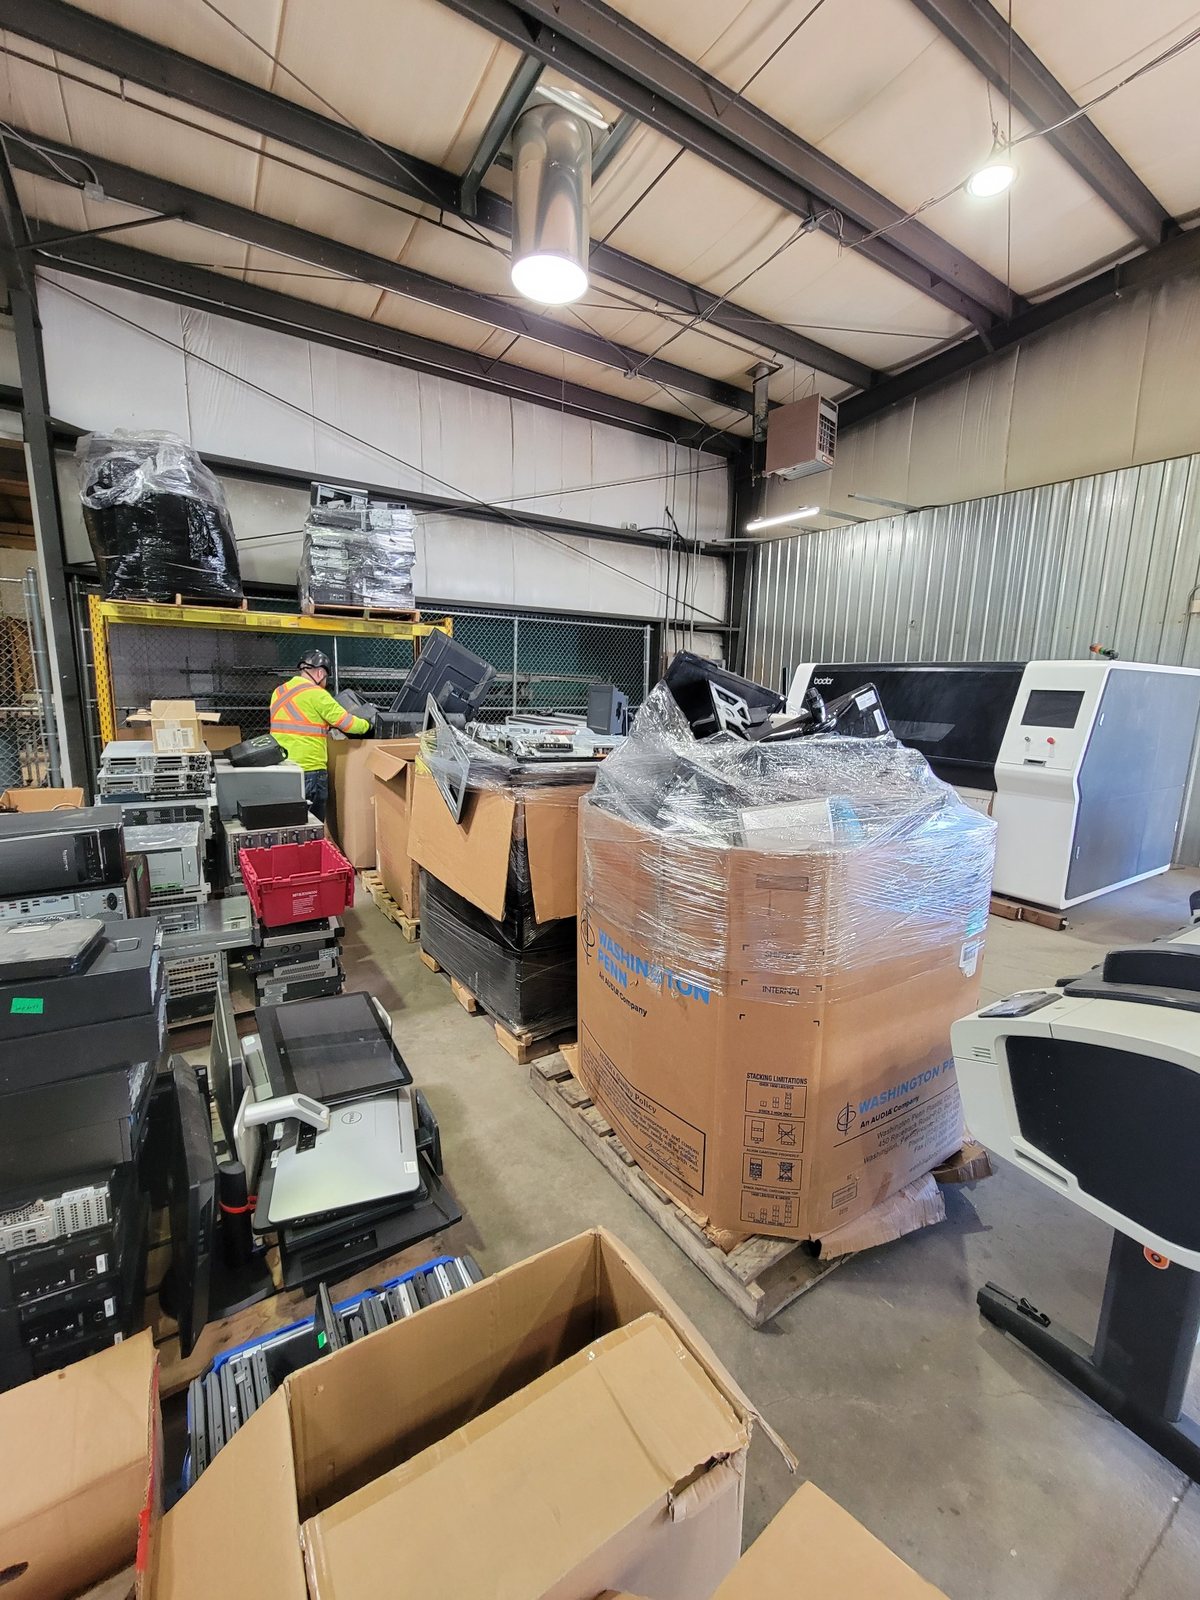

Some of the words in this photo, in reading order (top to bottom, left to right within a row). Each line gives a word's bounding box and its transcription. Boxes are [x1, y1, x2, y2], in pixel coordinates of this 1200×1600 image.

[597, 947, 628, 990] PENN
[619, 992, 648, 1018] Company
[746, 1072, 773, 1082] STACKING
[773, 1075, 808, 1085] LIMITATIONS
[858, 1066, 940, 1114] WASHINGTON
[634, 1092, 657, 1114] Policy
[860, 1120, 870, 1129] An
[893, 1095, 920, 1113] Company
